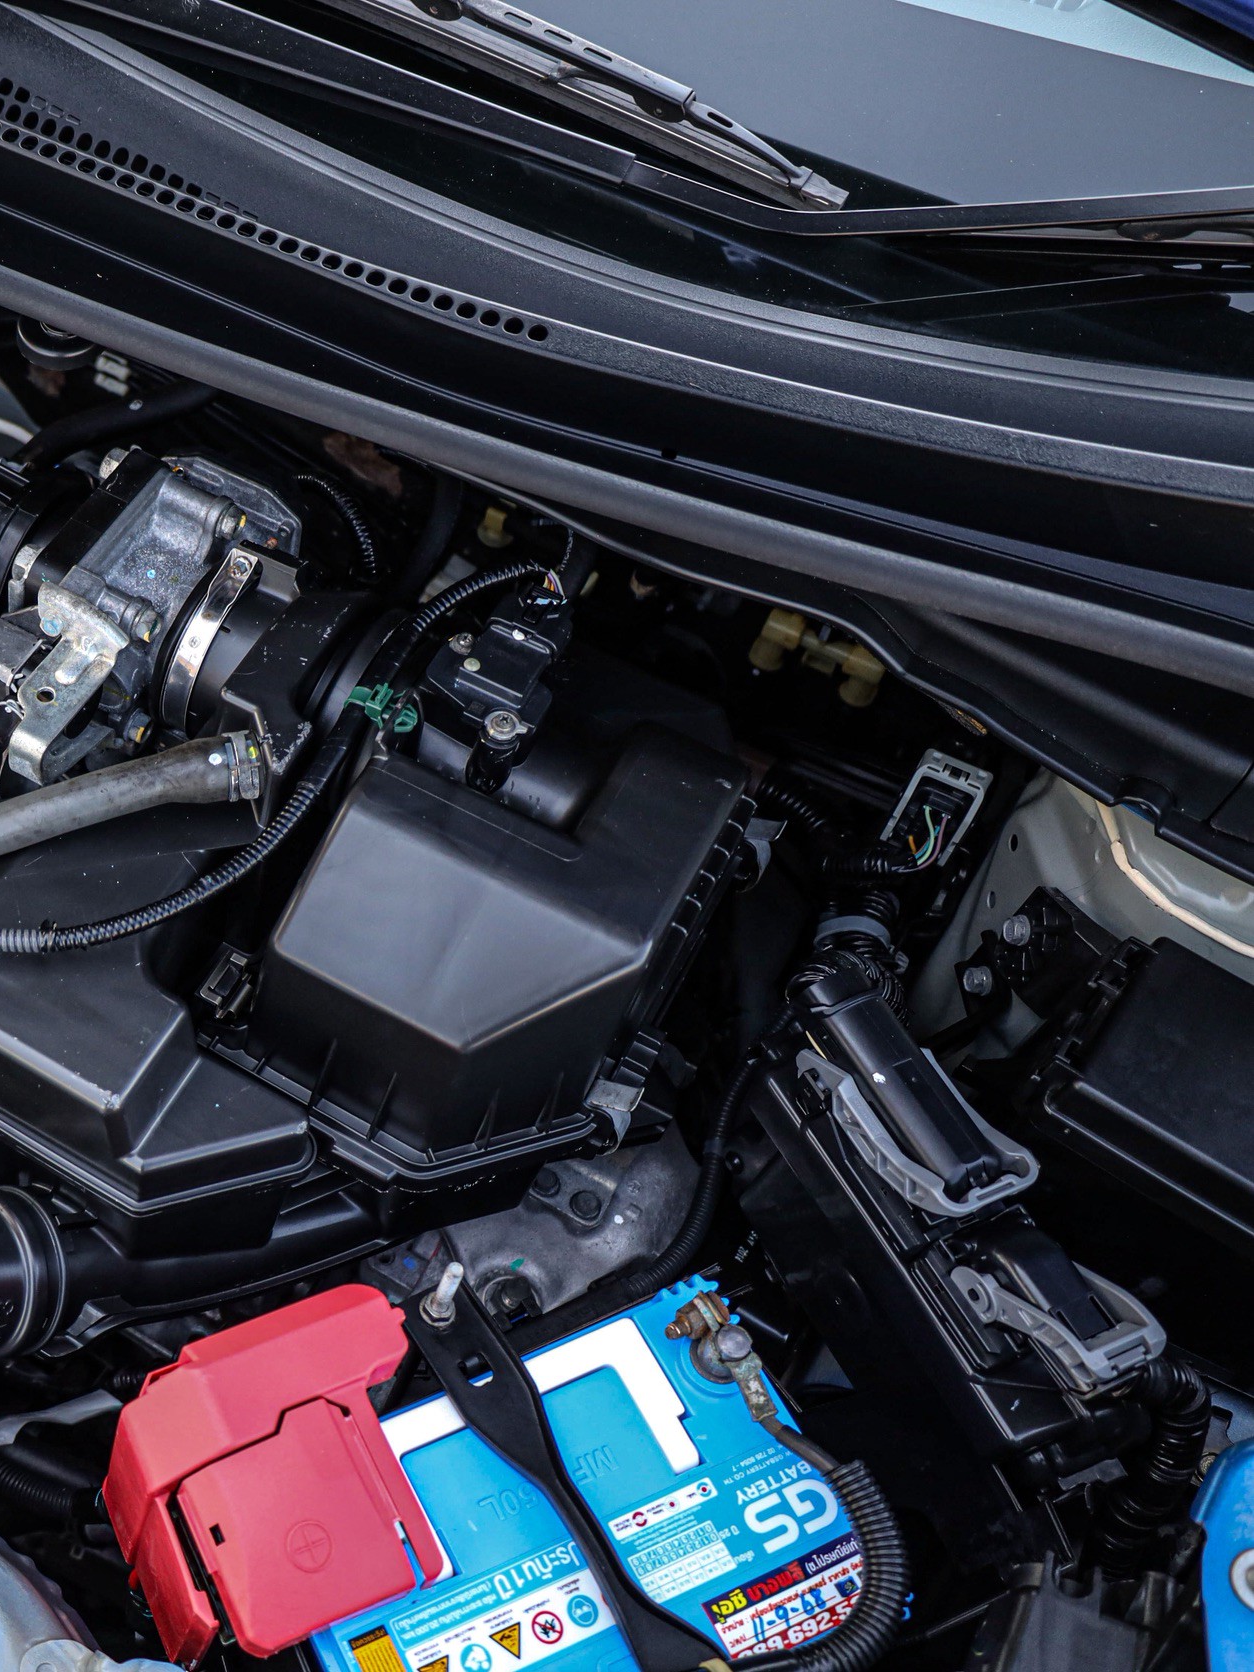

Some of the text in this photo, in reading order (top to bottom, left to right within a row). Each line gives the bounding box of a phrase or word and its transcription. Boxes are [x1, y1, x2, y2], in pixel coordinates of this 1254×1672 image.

[573, 1444, 619, 1486] MF
[736, 1460, 812, 1505] BATTERY
[478, 1480, 538, 1521] 50L
[744, 1478, 839, 1554] GS
[719, 1529, 731, 1539] 25
[746, 1560, 806, 1601] บางพลี
